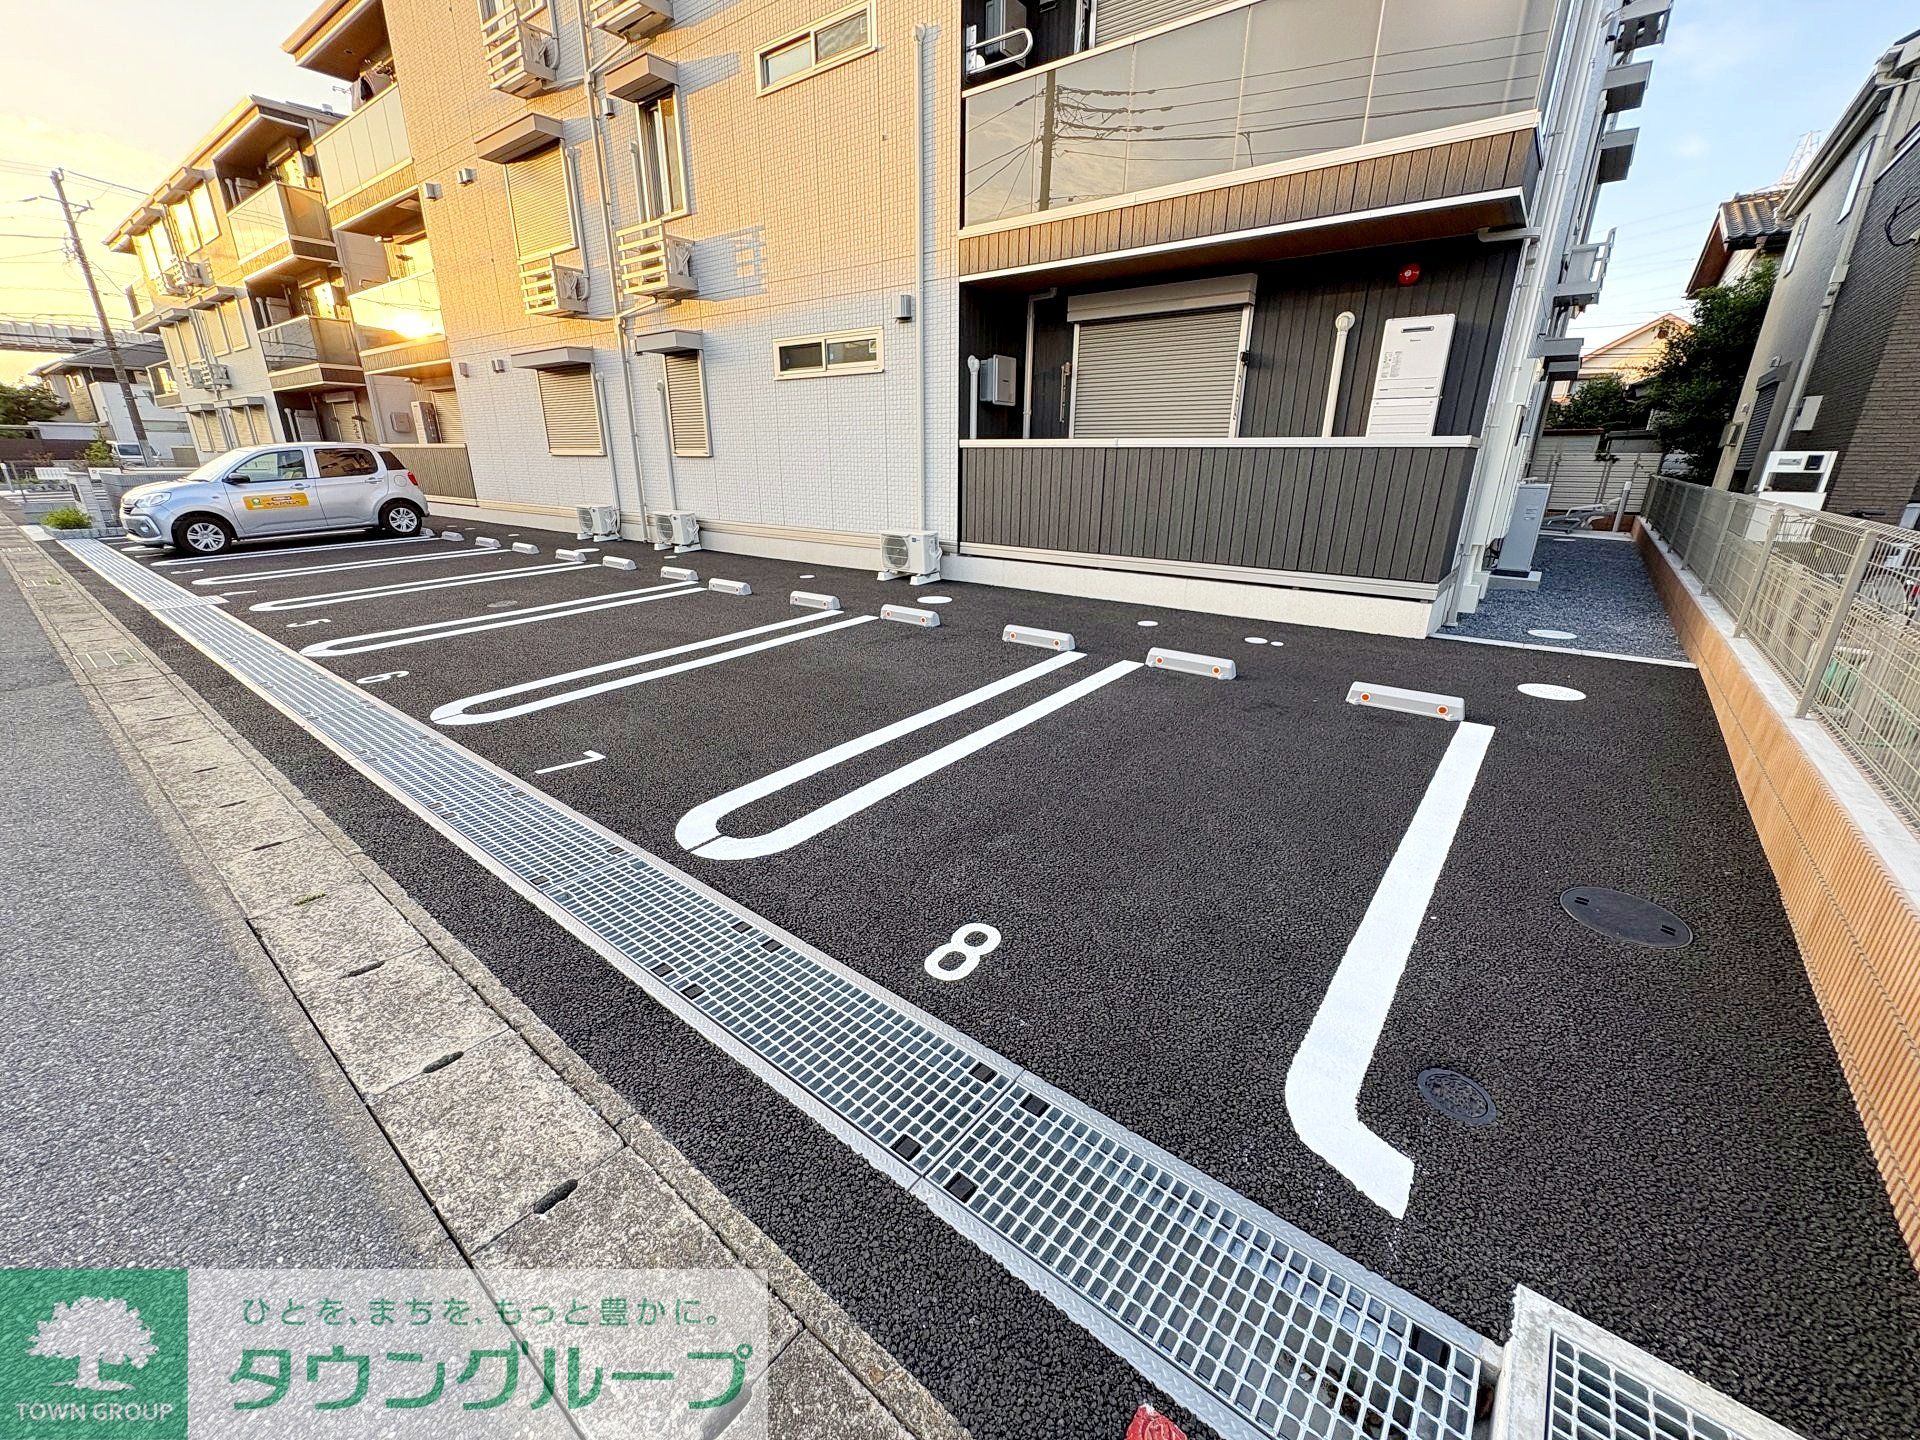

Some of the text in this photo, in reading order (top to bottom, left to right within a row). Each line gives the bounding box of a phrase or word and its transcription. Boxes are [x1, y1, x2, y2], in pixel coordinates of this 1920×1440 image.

[285, 618, 332, 628] 5
[356, 671, 410, 685] 6
[923, 922, 1002, 982] 8
